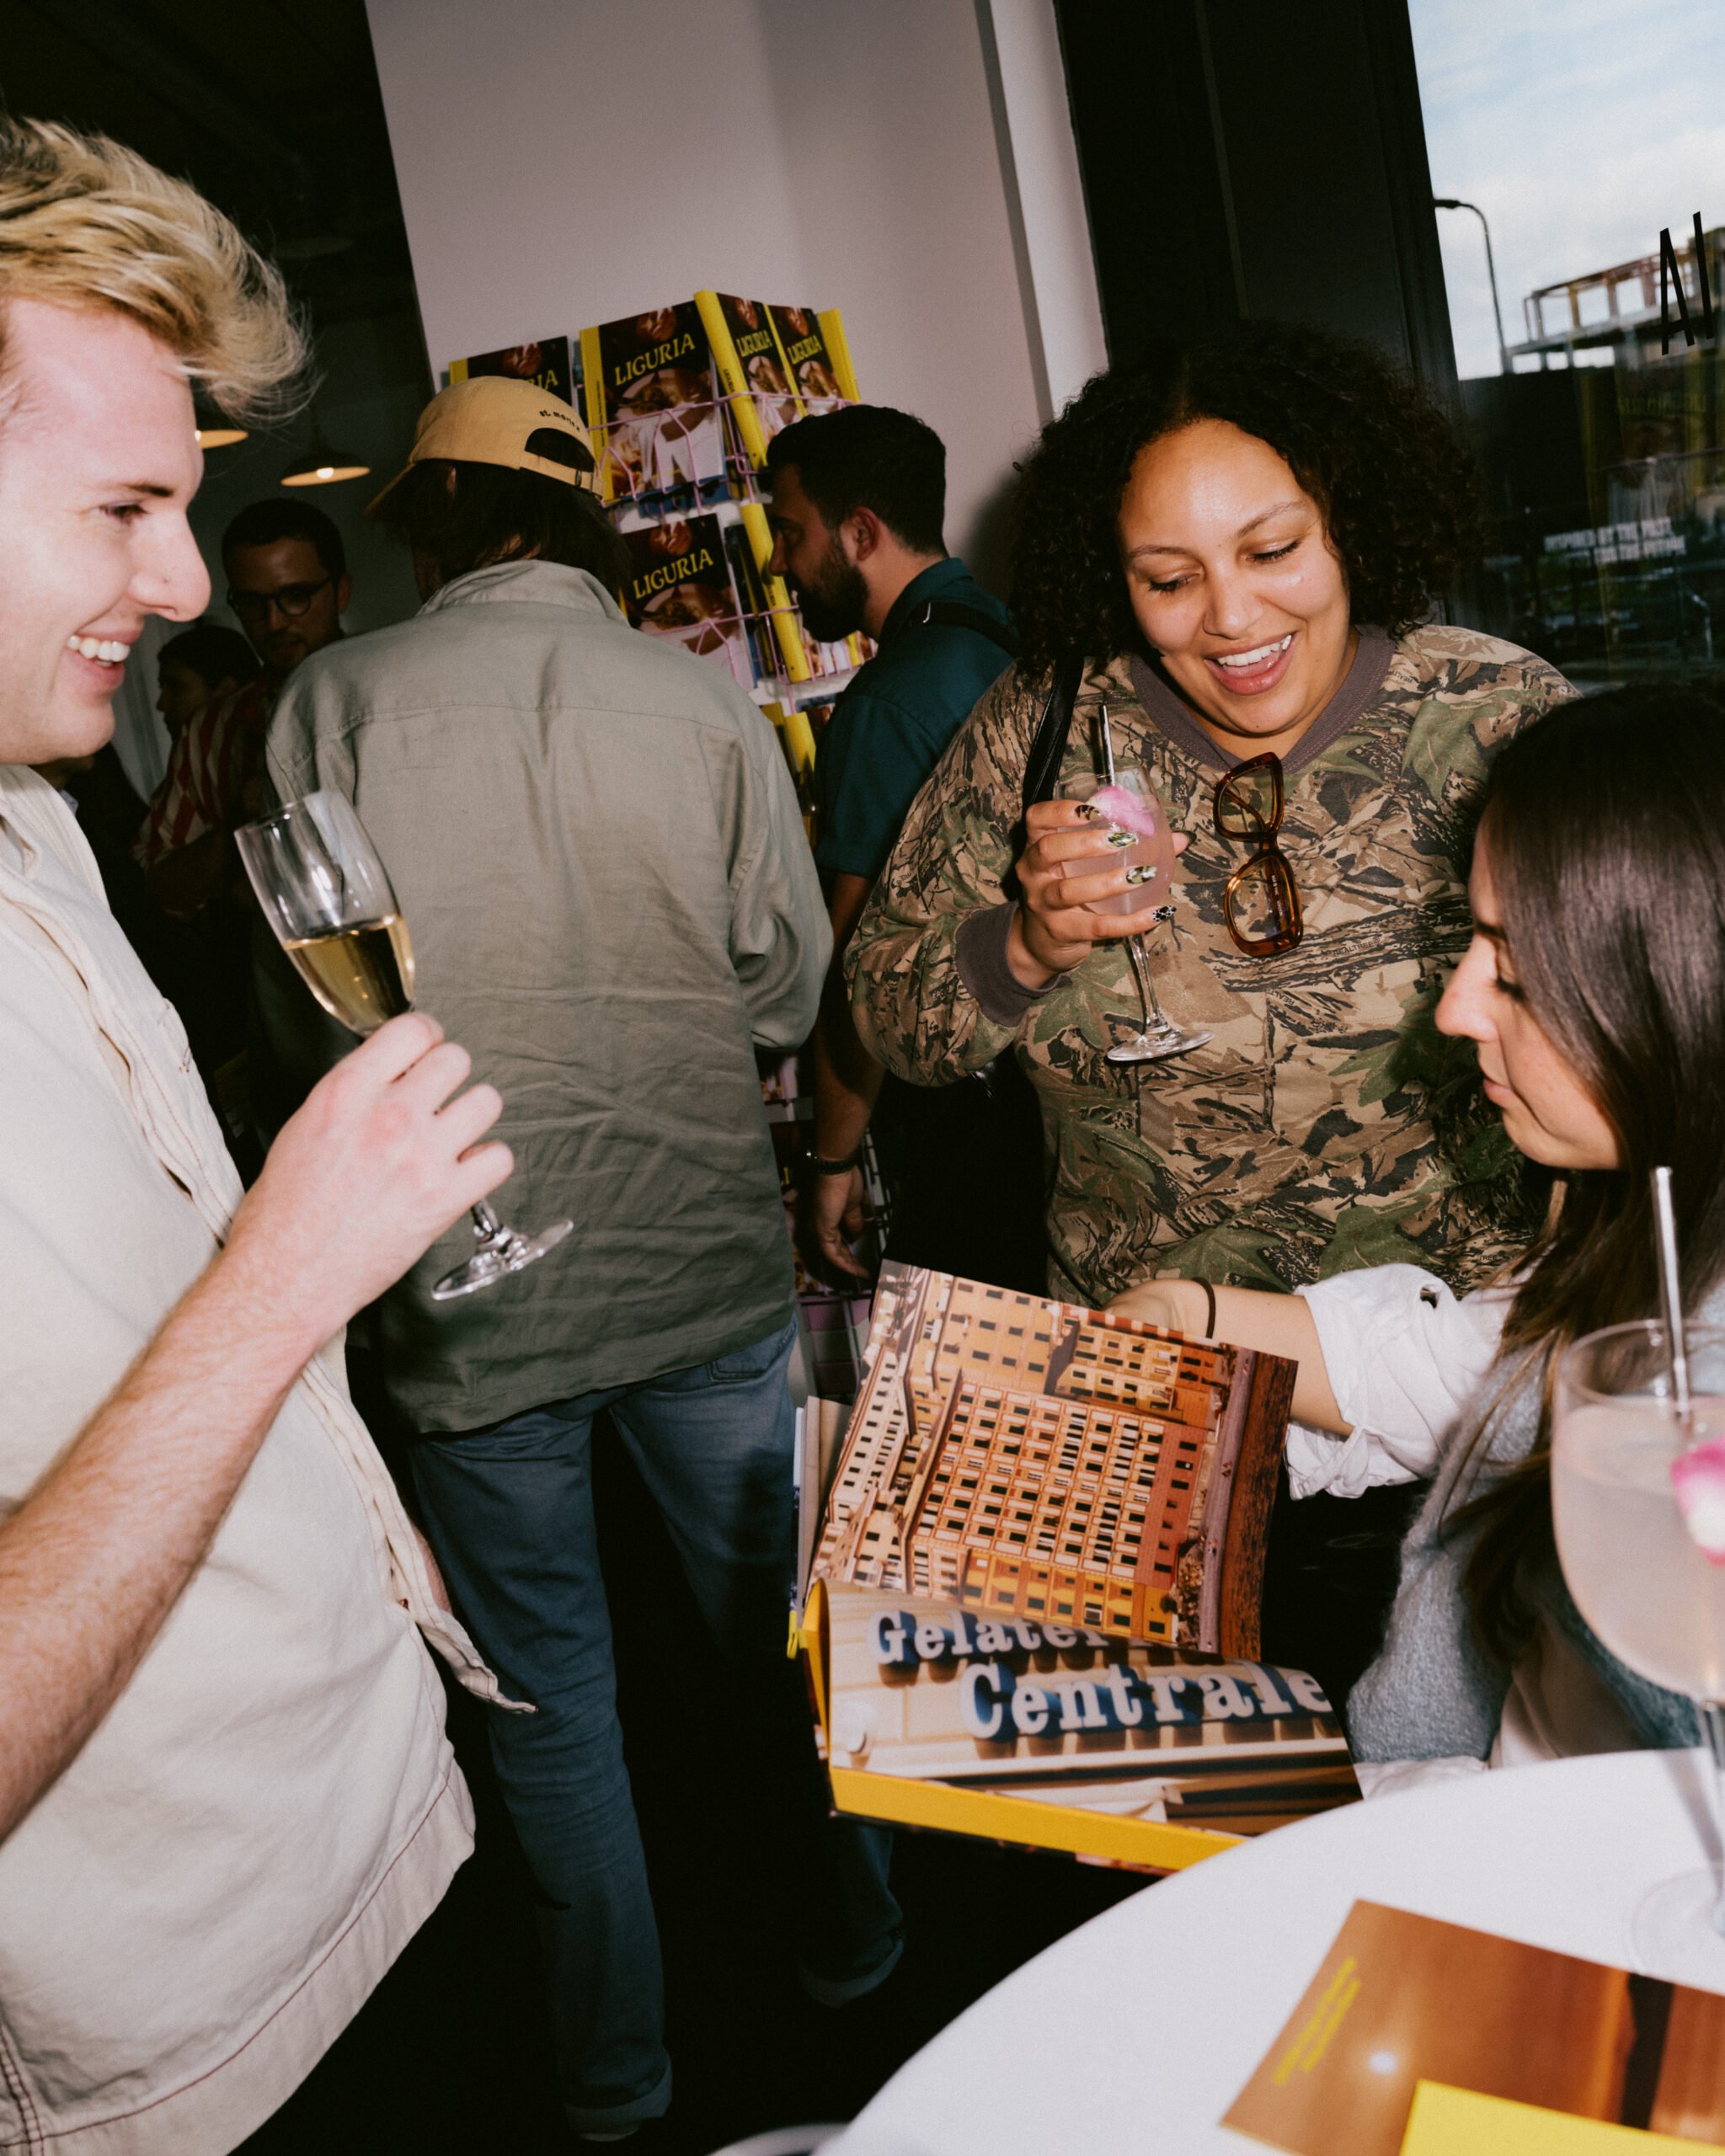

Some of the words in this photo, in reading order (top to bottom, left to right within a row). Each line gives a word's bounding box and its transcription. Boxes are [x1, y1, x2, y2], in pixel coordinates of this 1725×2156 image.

[614, 333, 696, 386] LIGURIA
[735, 329, 773, 357] LIGURIA
[787, 334, 823, 365] LIGURIA
[633, 548, 714, 600] LIGURIA
[960, 1657, 1333, 1740] Centrale
